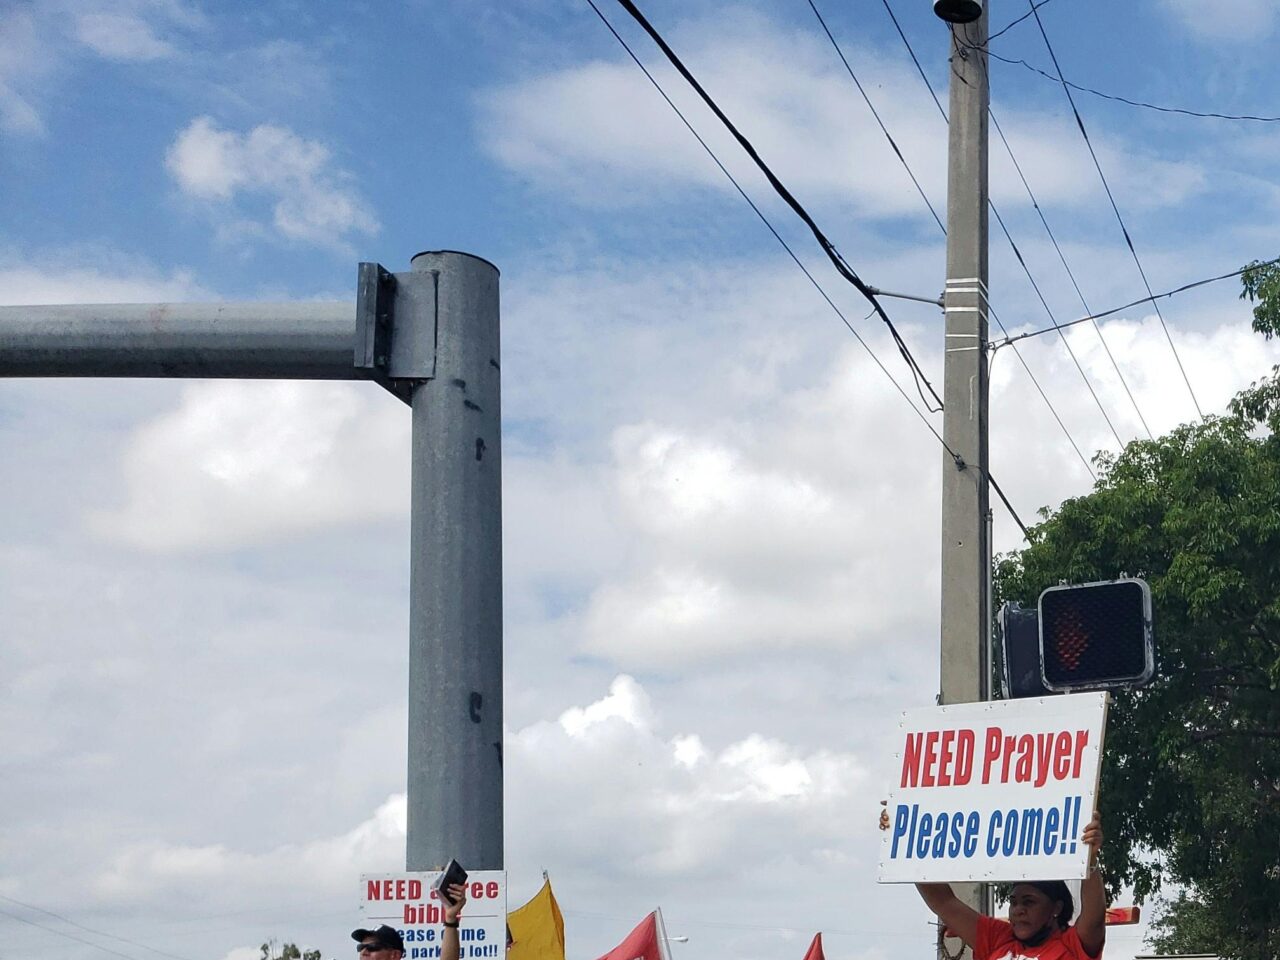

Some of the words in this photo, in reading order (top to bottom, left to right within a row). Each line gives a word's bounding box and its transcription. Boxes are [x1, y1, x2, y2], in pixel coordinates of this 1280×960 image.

[900, 729, 975, 788] NEED
[981, 727, 1089, 788] Prayer
[890, 804, 980, 859] Please
[986, 796, 1082, 858] come!!
[367, 880, 421, 900] NEED
[469, 944, 498, 957] lot!!
